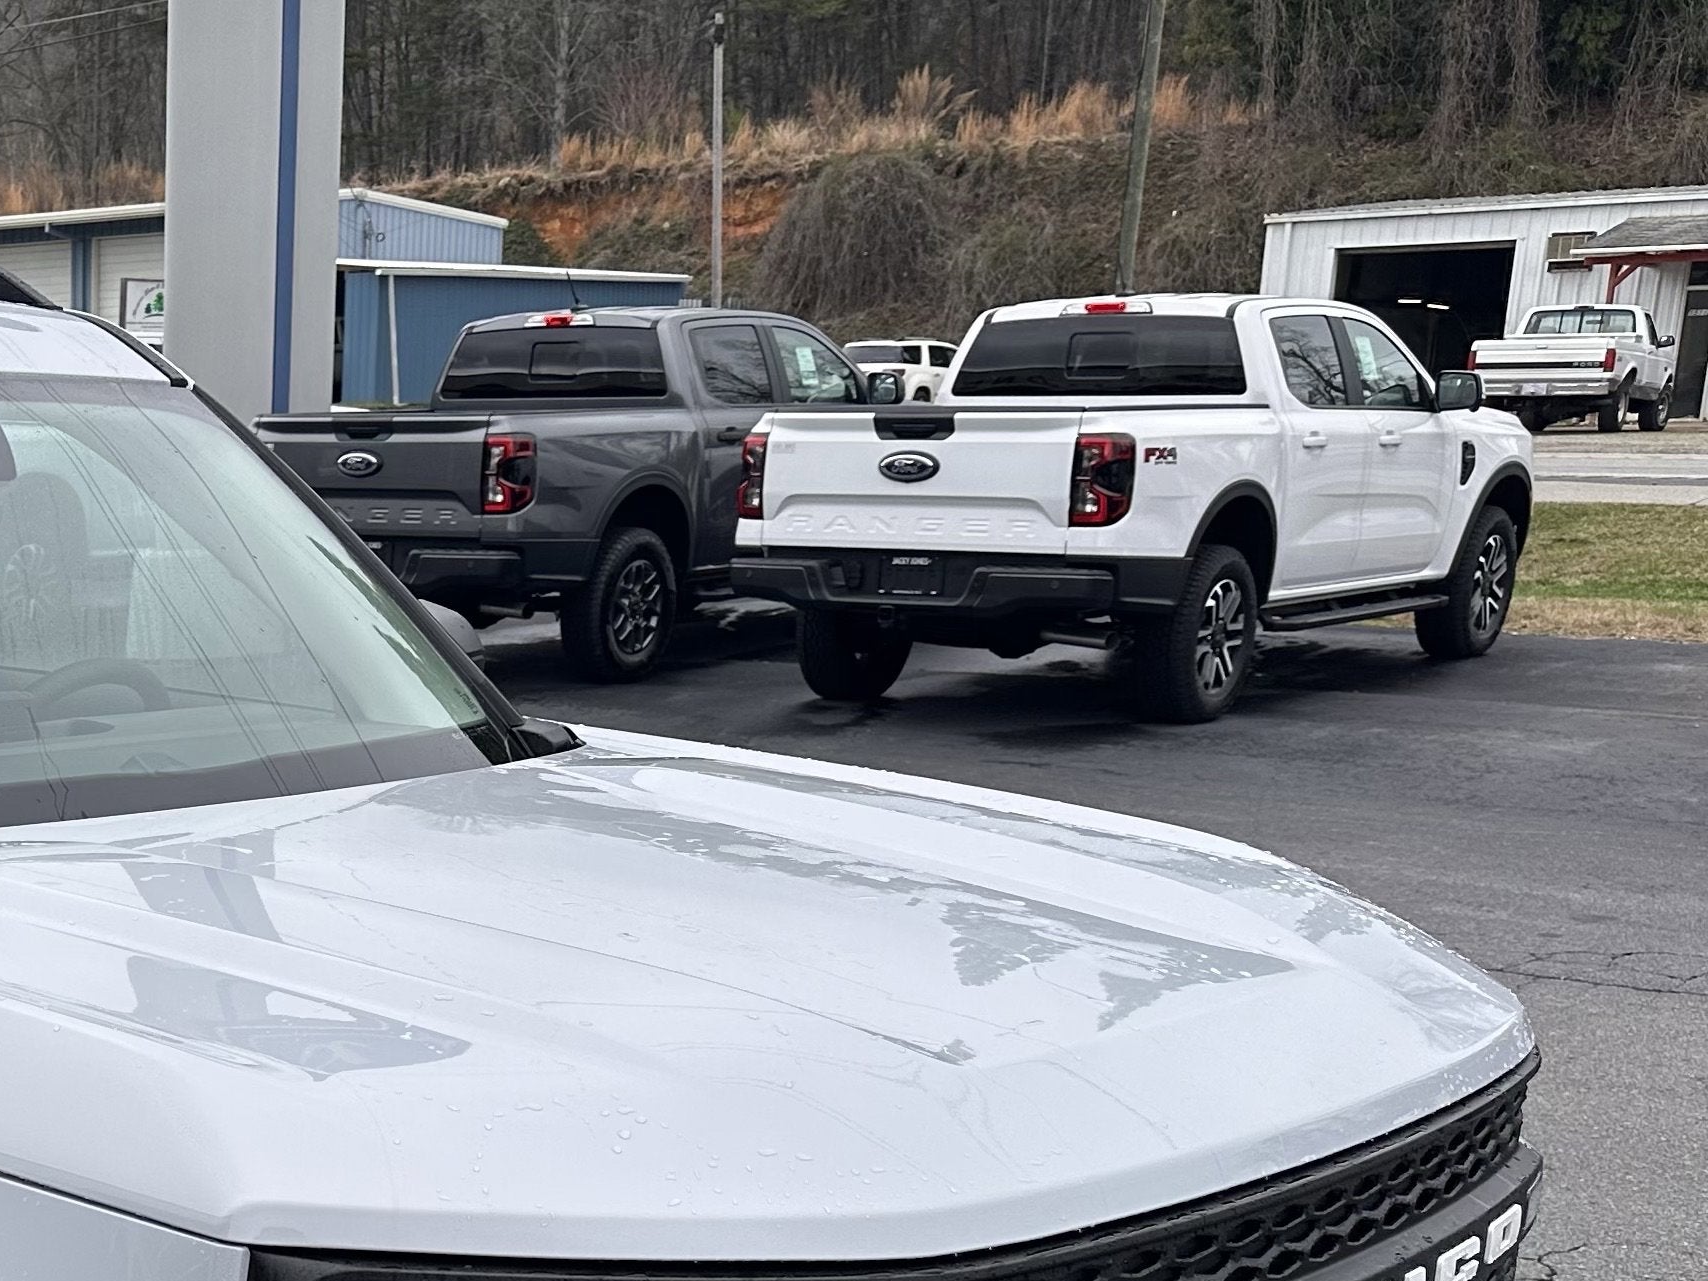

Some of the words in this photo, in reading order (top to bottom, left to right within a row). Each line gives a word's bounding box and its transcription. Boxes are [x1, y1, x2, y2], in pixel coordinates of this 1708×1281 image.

[1144, 447, 1177, 463] FX4
[335, 507, 458, 524] NGER
[785, 514, 1038, 538] RANGER
